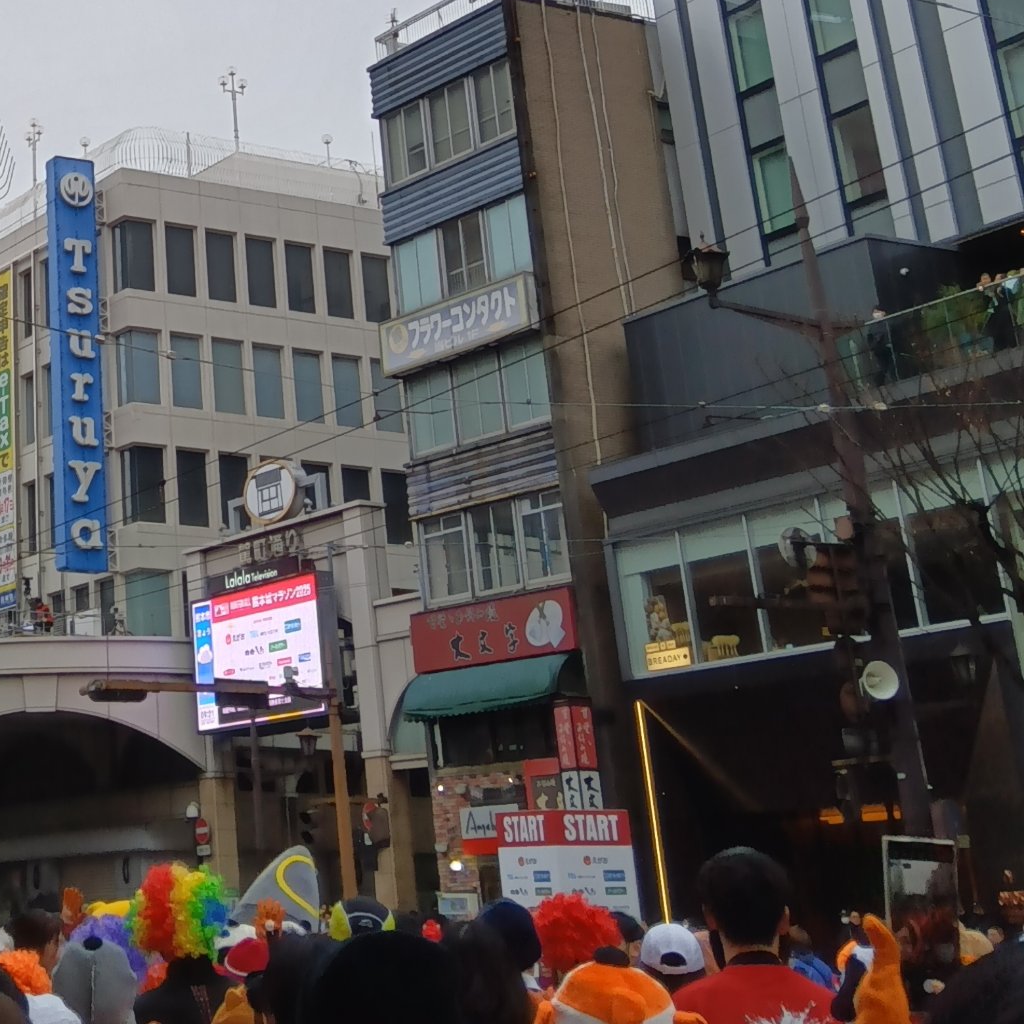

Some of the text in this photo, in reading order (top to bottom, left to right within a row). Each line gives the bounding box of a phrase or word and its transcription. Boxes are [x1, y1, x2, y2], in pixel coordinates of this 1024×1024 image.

[407, 286, 516, 350] フラワーコンタクト
[62, 237, 105, 551] Tsuruya
[225, 568, 278, 589] Lalala Television
[647, 653, 682, 666] BREADAY
[503, 814, 546, 843] START
[563, 814, 619, 842] START
